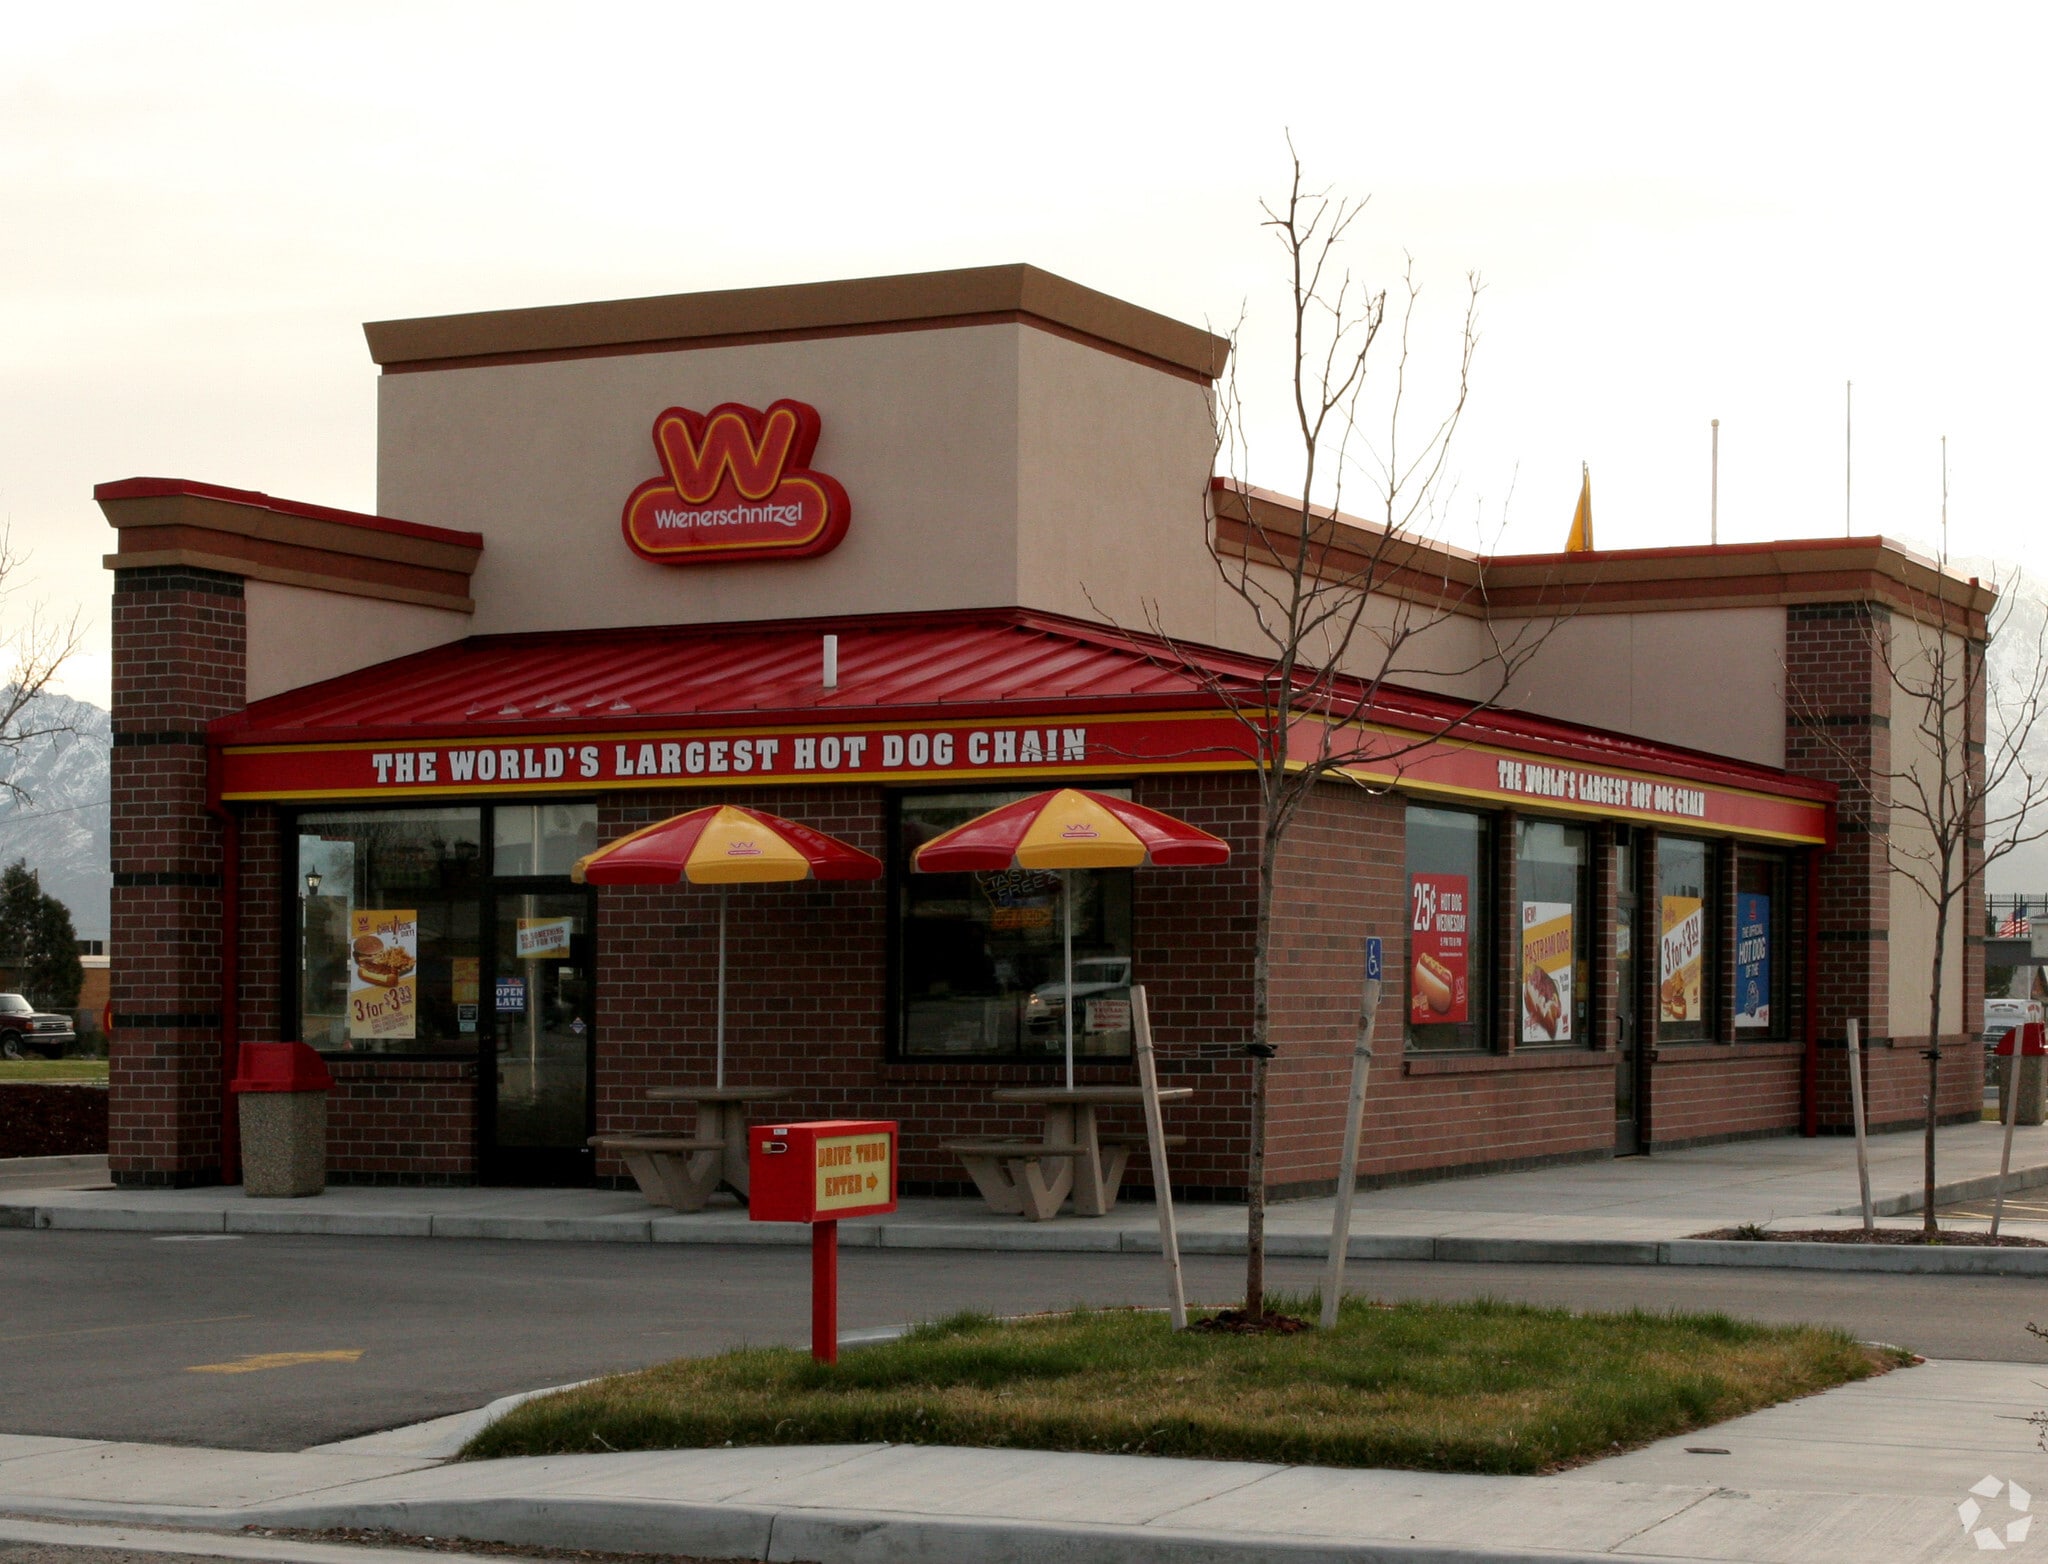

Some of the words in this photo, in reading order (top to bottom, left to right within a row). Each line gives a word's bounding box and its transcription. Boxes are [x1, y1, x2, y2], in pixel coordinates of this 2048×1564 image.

[660, 409, 797, 503] W
[655, 502, 802, 529] Wienerschnitzel
[372, 752, 437, 783] THE
[449, 746, 599, 781] WORLD'S
[615, 739, 779, 776] LARGEST
[794, 736, 866, 769] HOT
[882, 733, 953, 767] DOG
[968, 728, 1086, 764] CHAIN
[1498, 759, 1522, 791] THE
[1525, 764, 1575, 799] WORLD'S
[1579, 773, 1628, 806] LARGEST
[1631, 782, 1651, 809] HOT
[1653, 785, 1674, 812] DOG
[1675, 788, 1704, 817] CHAIN
[1440, 893, 1451, 911] HOT
[1451, 893, 1462, 911] DOG
[1664, 938, 1671, 975] 3
[1671, 941, 1683, 969] for
[1739, 940, 1752, 965] HOT
[1752, 937, 1766, 961] DOG
[496, 987, 523, 997] OPEN
[496, 997, 523, 1006] LATE
[354, 999, 364, 1021] 3
[366, 1002, 384, 1018] for
[818, 1146, 851, 1167] DRIVE
[856, 1142, 885, 1163] THRU
[825, 1174, 862, 1197] ENTER
